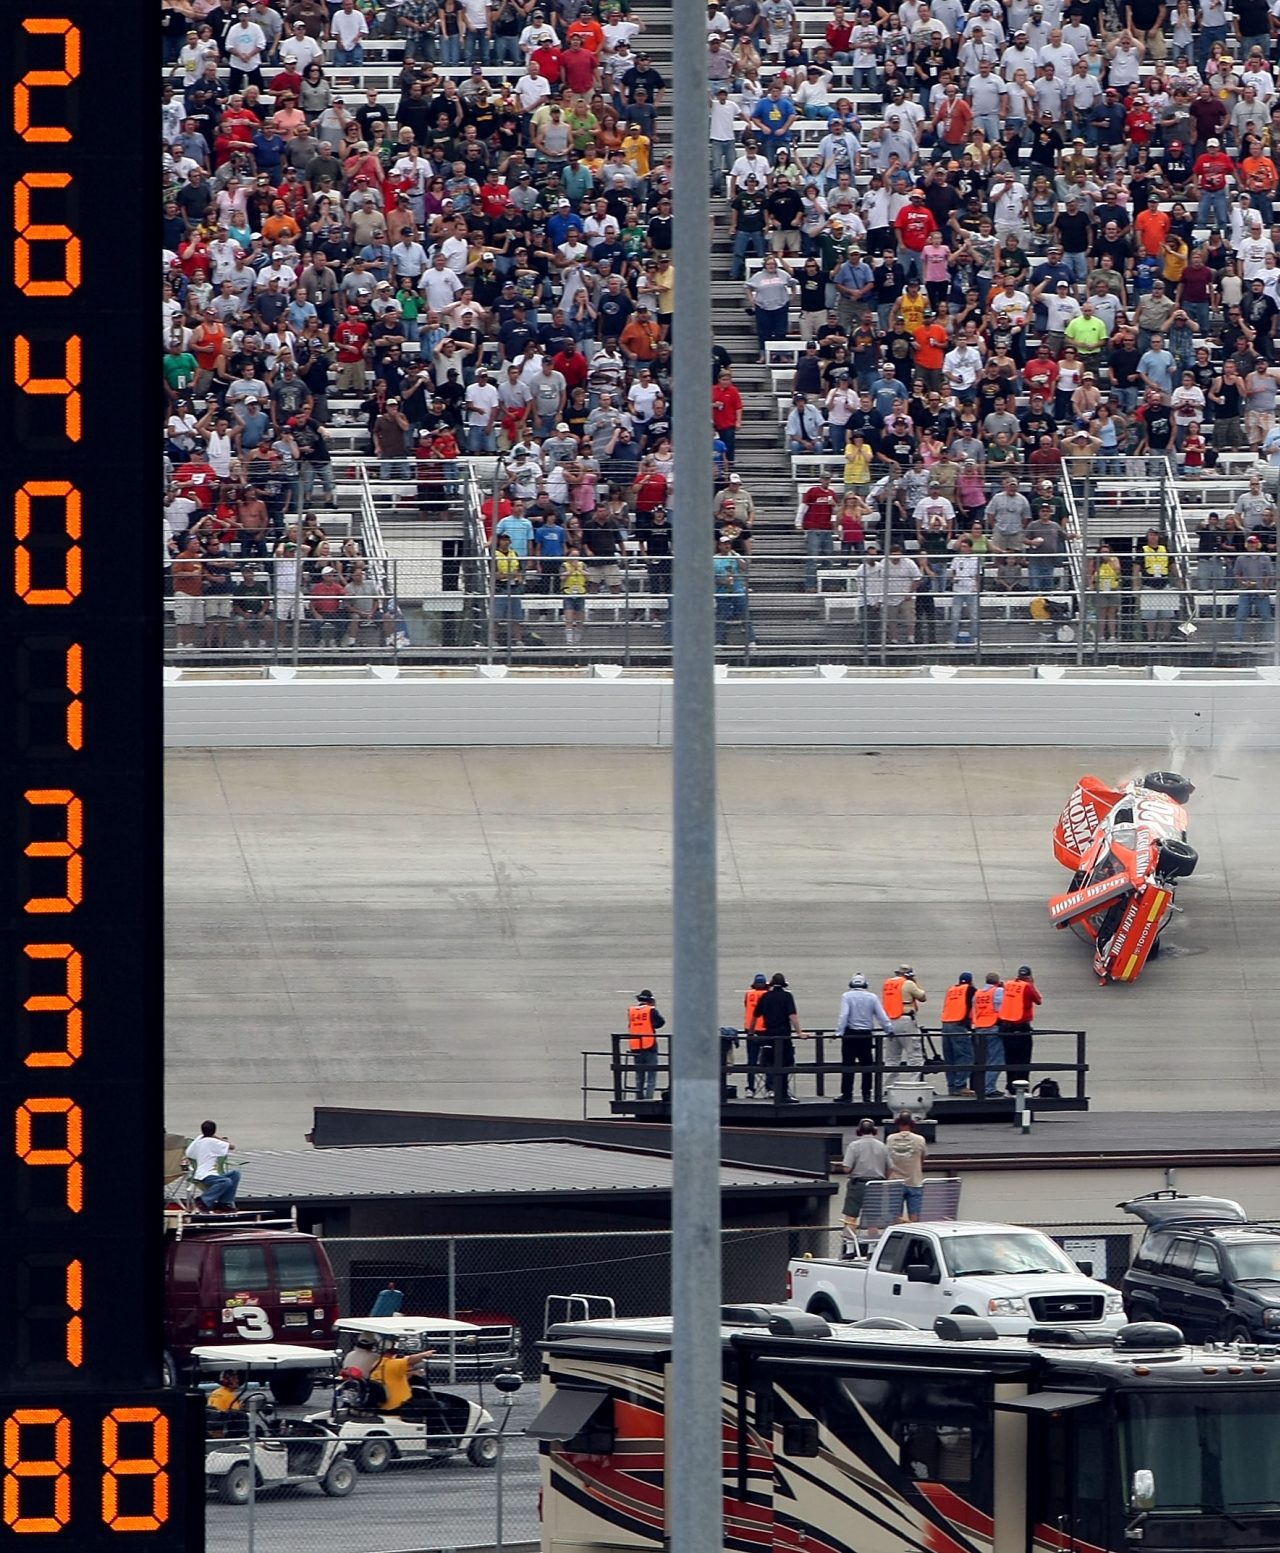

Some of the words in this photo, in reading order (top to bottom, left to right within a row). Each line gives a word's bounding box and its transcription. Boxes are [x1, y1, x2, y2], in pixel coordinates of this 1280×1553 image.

[13, 18, 80, 143] 2
[13, 172, 82, 297] 6
[14, 334, 82, 443] 4
[14, 480, 82, 605] 0
[66, 643, 82, 750] 1
[23, 789, 83, 914] 3
[1050, 893, 1085, 917] HOME
[1086, 876, 1129, 900] DEPOT
[1111, 932, 1128, 956] HOME
[1122, 904, 1139, 935] DEPOT
[1137, 921, 1152, 949] TOYOTA
[24, 943, 83, 1067] 3
[15, 1097, 83, 1213] 9
[66, 1258, 83, 1367] 1
[233, 1306, 274, 1340] 3
[3, 1407, 169, 1532] 88
